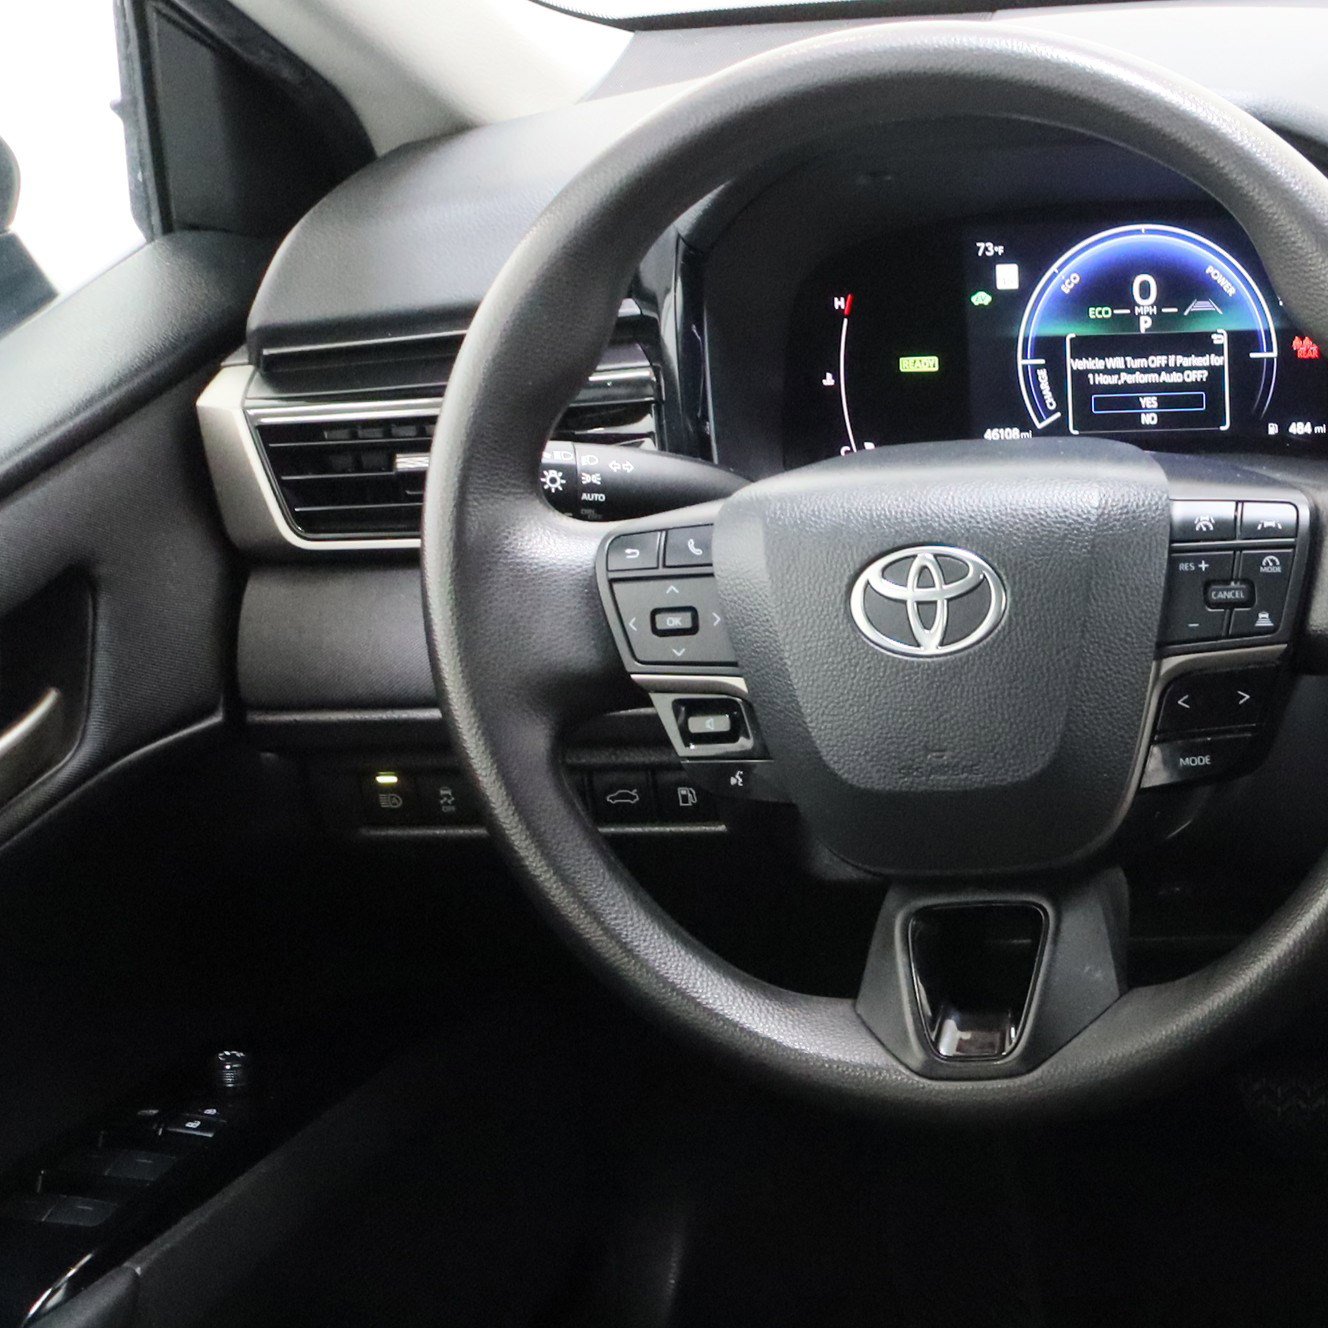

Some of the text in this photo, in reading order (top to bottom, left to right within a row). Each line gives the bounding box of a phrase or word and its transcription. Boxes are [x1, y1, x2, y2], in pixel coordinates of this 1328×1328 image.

[1061, 273, 1081, 294] ECO
[1205, 266, 1236, 297] POWER
[834, 297, 845, 310] H
[1088, 307, 1112, 319] ECO
[1135, 306, 1157, 316] MPH
[1139, 316, 1152, 334] P
[1070, 357, 1104, 370] Vehicle
[1105, 356, 1125, 369] Will
[1126, 356, 1148, 369] Turn
[1149, 355, 1167, 368] OFF
[1176, 354, 1209, 367] Parked
[1210, 353, 1224, 366] for
[1160, 371, 1183, 383] Auto
[1184, 369, 1209, 382] OFF?
[1036, 368, 1057, 410] CHARGE
[1139, 396, 1158, 409] YES
[1140, 413, 1158, 425] NO
[983, 427, 1033, 440] 46108 mi
[1288, 422, 1326, 435] 484 mi
[581, 493, 606, 502] AUTO
[1179, 562, 1195, 571] RES
[1211, 589, 1245, 600] CANCEL
[666, 617, 682, 627] OK
[1179, 755, 1211, 766] MODE
